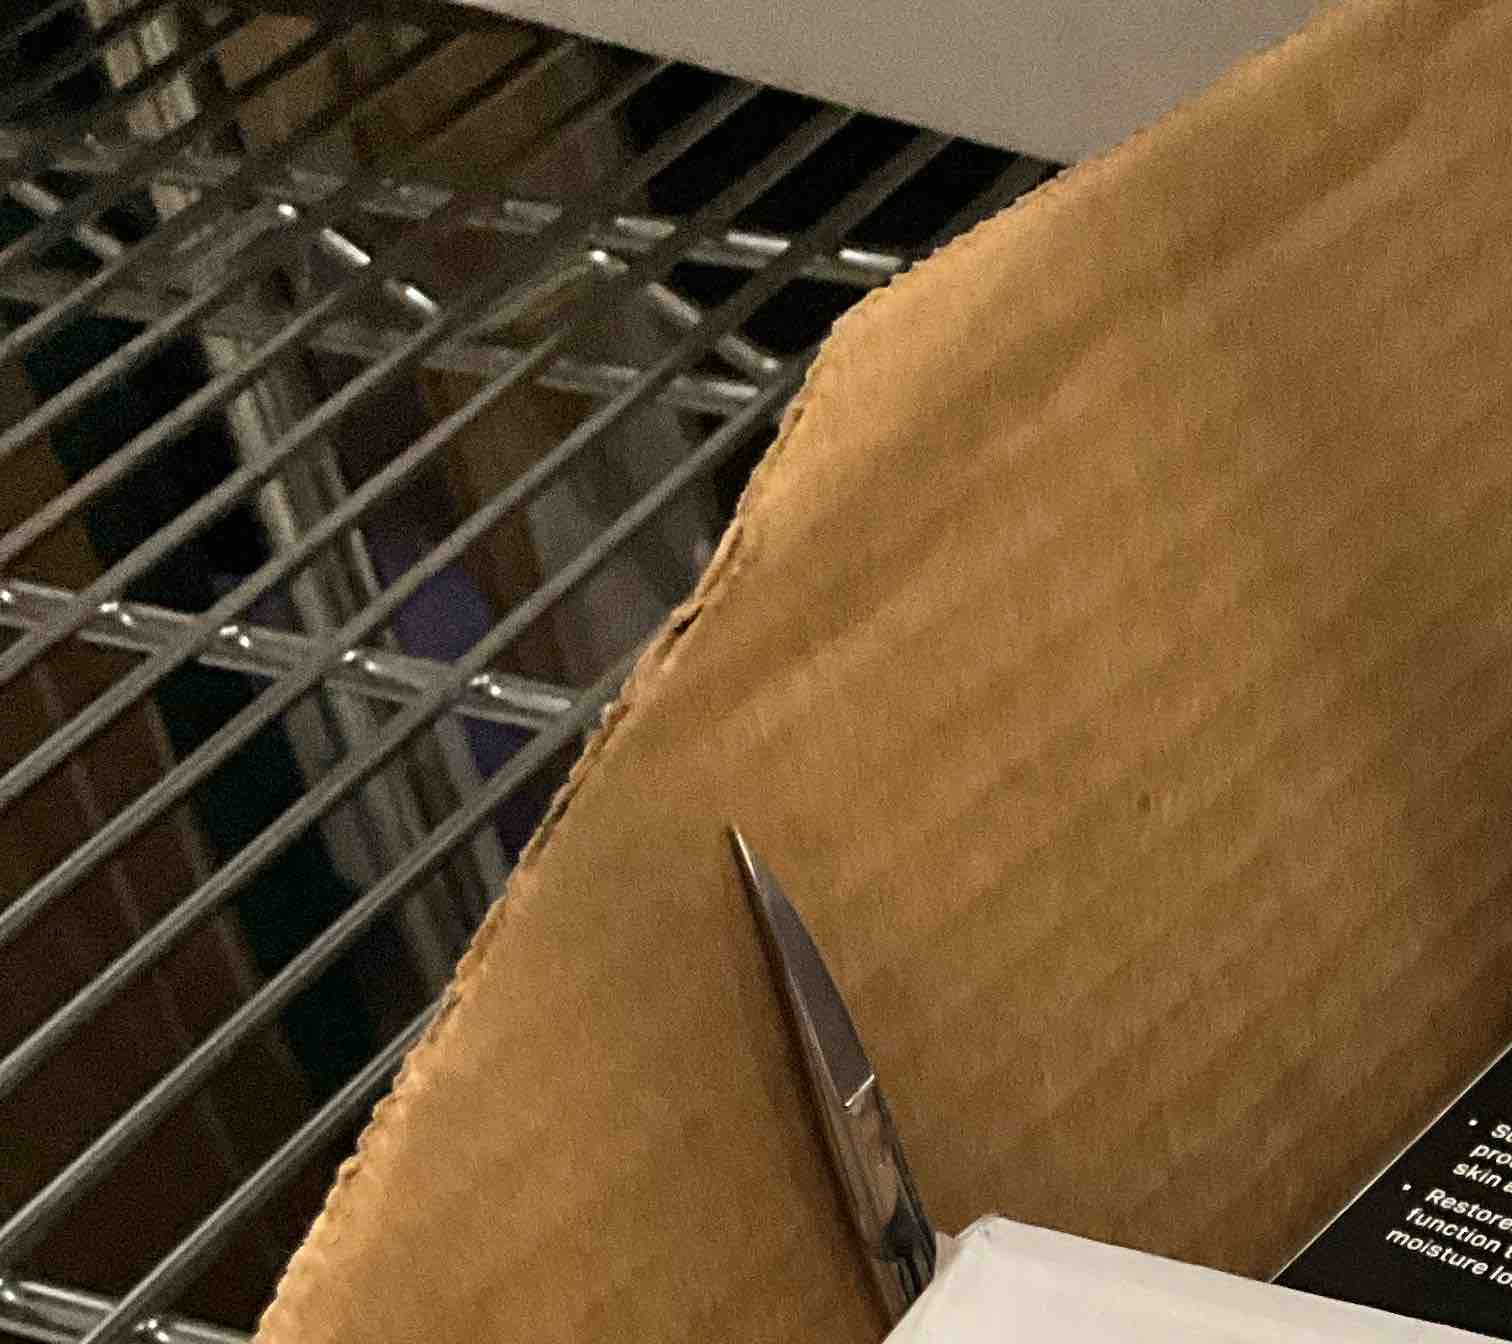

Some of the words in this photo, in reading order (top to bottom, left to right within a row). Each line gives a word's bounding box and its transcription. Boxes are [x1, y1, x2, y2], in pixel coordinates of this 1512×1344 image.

[1451, 1162, 1504, 1189] skin
[1384, 1228, 1490, 1276] moisture
[1404, 1206, 1503, 1254] function
